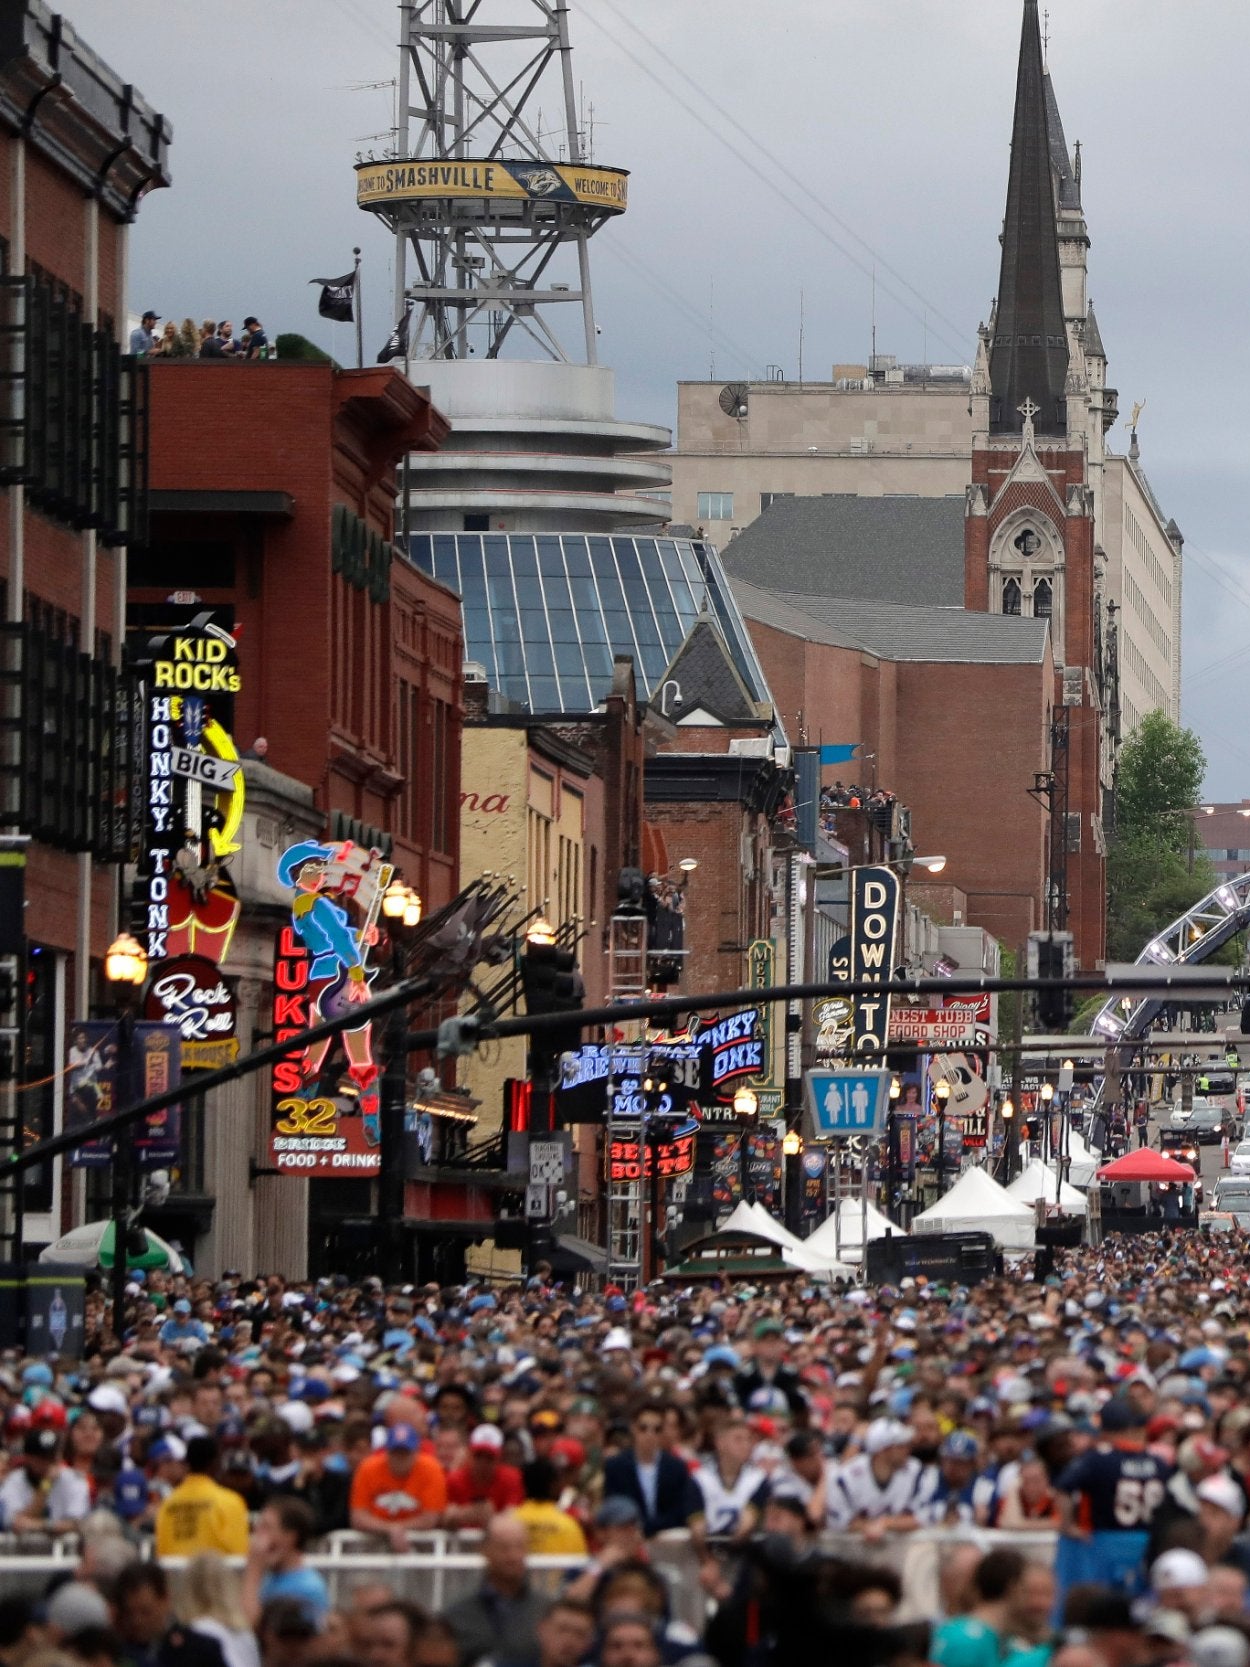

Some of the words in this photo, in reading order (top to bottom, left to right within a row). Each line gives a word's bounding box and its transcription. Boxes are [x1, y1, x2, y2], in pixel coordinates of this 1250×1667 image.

[386, 167, 494, 192] SMASHVILLE
[575, 178, 609, 196] WELCOME
[174, 637, 227, 663] KID
[150, 696, 171, 832] HONKY
[176, 751, 217, 780] BIG
[148, 848, 169, 957] TONK
[154, 973, 231, 1010] Rock
[181, 1007, 233, 1039] Roll
[936, 1009, 973, 1023] TUBB
[934, 1025, 966, 1038] SHOP
[713, 1042, 762, 1079] ONK
[276, 1098, 337, 1134] 32
[963, 1118, 986, 1136] ILL
[273, 1137, 347, 1151] BRIDGE
[611, 1136, 693, 1159] BETTY
[278, 1153, 314, 1167] FOOD
[611, 1155, 691, 1178] BOOTS
